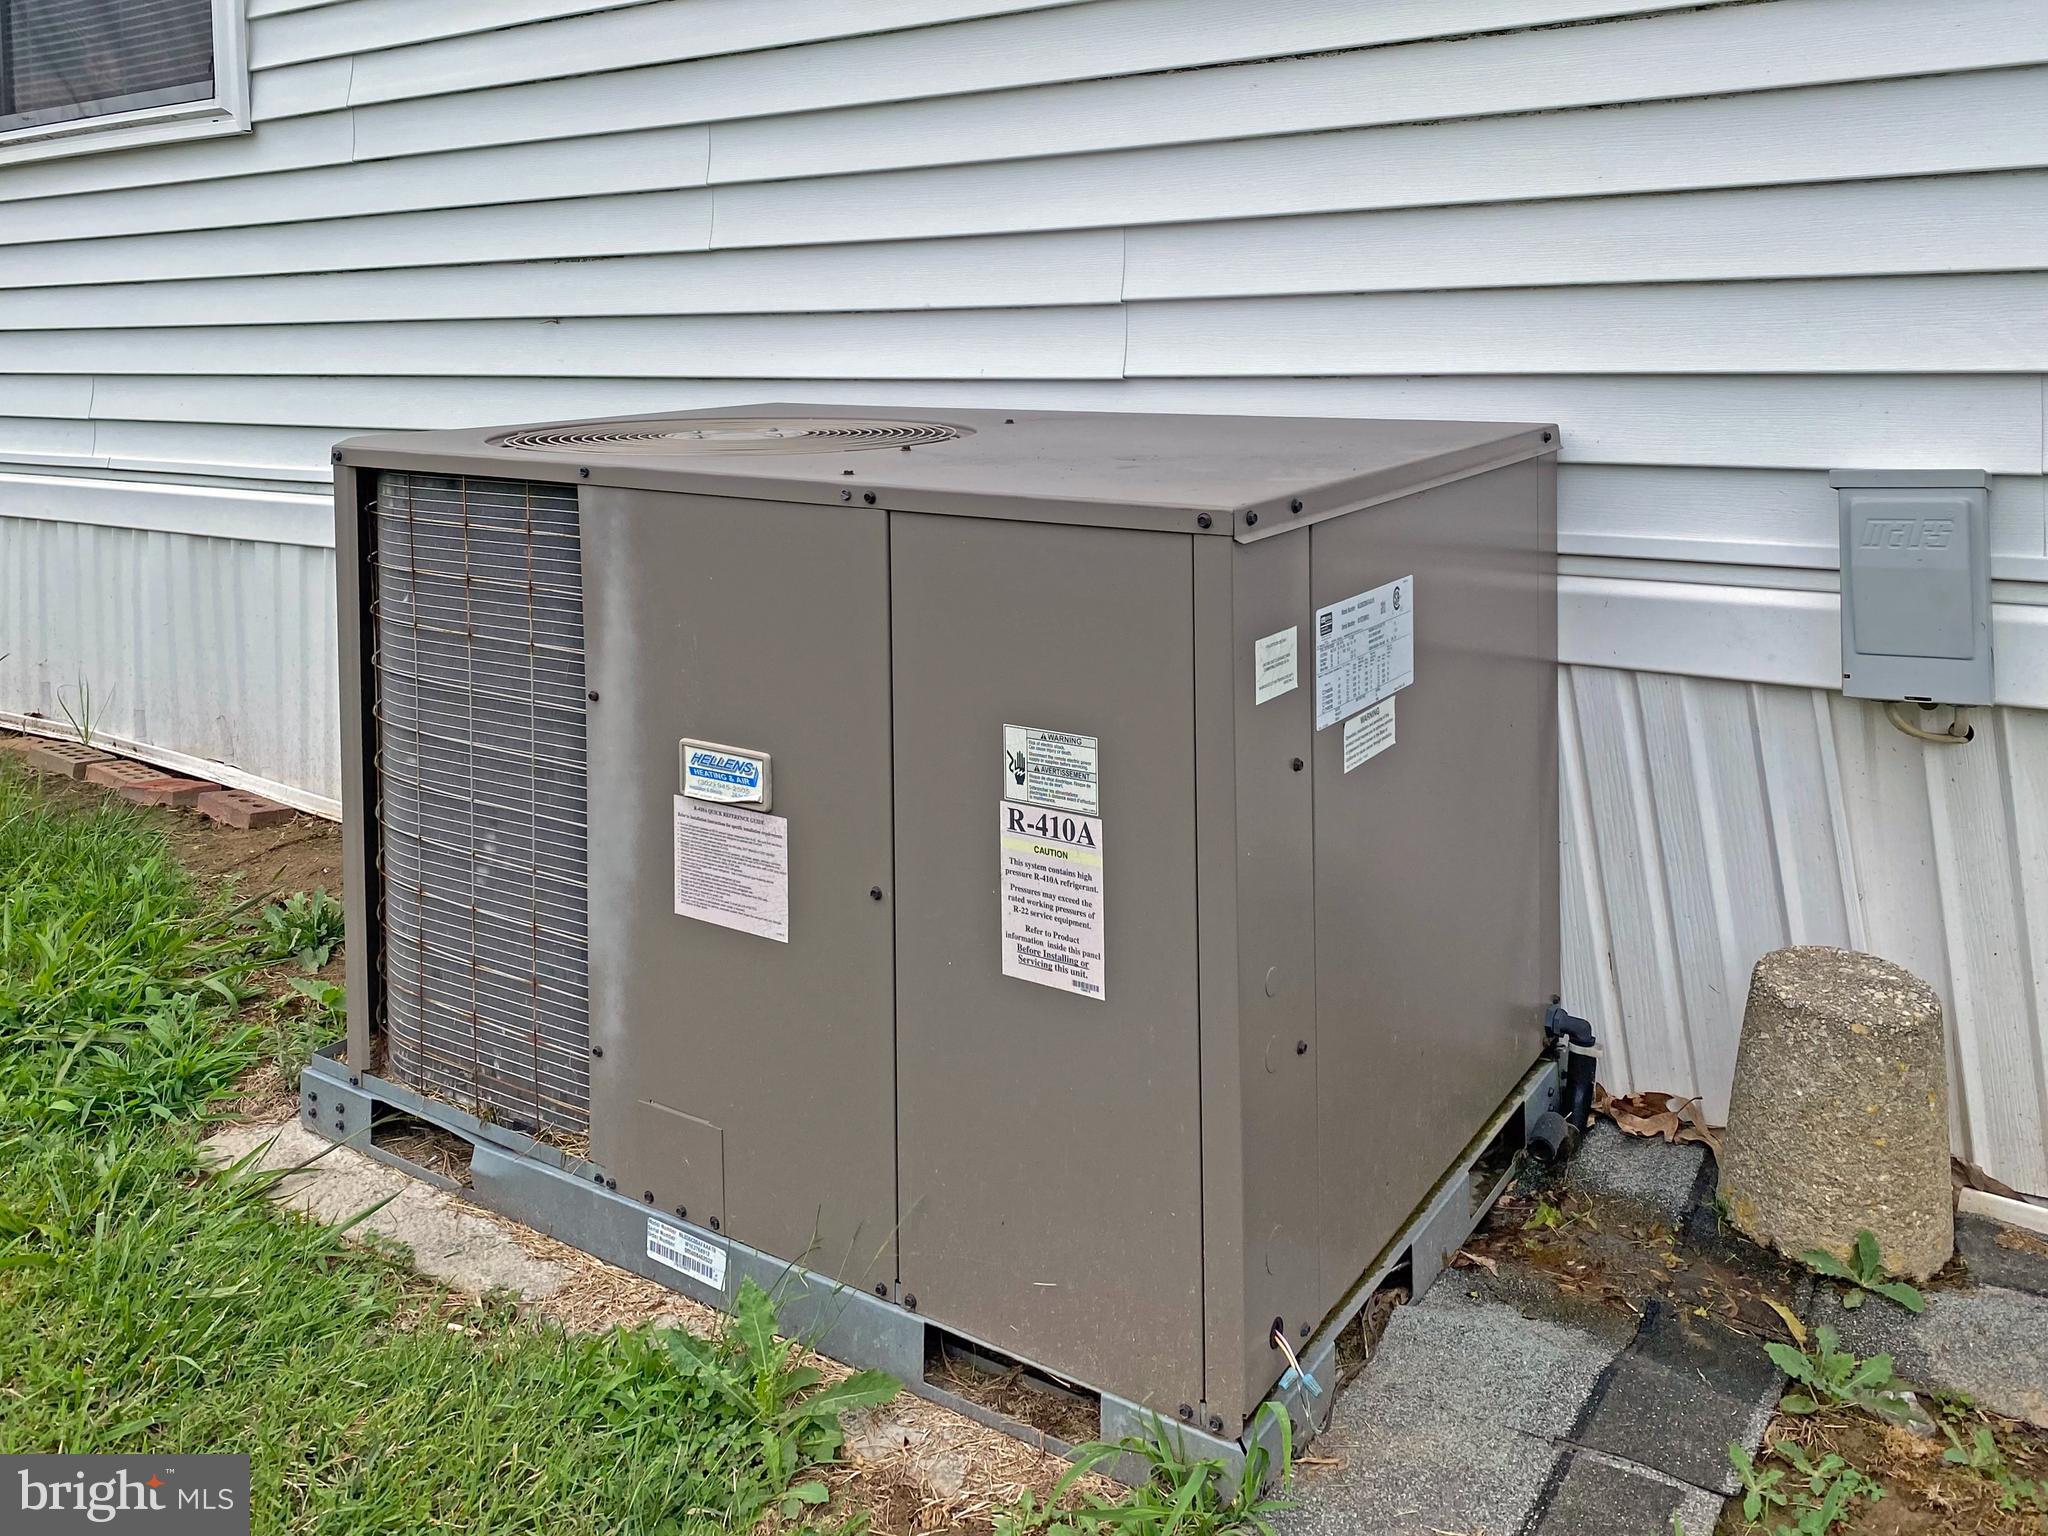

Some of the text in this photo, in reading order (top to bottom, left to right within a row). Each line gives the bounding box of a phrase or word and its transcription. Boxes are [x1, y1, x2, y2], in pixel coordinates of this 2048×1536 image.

[1360, 707, 1380, 724] WARNING
[1047, 733, 1082, 745] WARNING
[691, 752, 754, 776] HELLENS
[1041, 766, 1090, 780] AVERTISSEMENT
[694, 769, 727, 781] HEATING
[736, 776, 750, 785] AIR
[1007, 807, 1096, 847] R-410A
[1034, 846, 1069, 859] CAUTION
[1009, 857, 1093, 882] This system contains high
[1005, 869, 1099, 895] pressure R-410A refrigerant.
[1008, 895, 1096, 919] rated working pressures of
[1010, 884, 1093, 908] Pressures may exceed the
[1013, 905, 1092, 930] R-22 service equipment.
[1005, 932, 1101, 961] information inside this panel
[1025, 925, 1080, 944] Refer to Product
[1017, 943, 1090, 968] Before Installing or
[1017, 955, 1089, 979] Servicing this unit.
